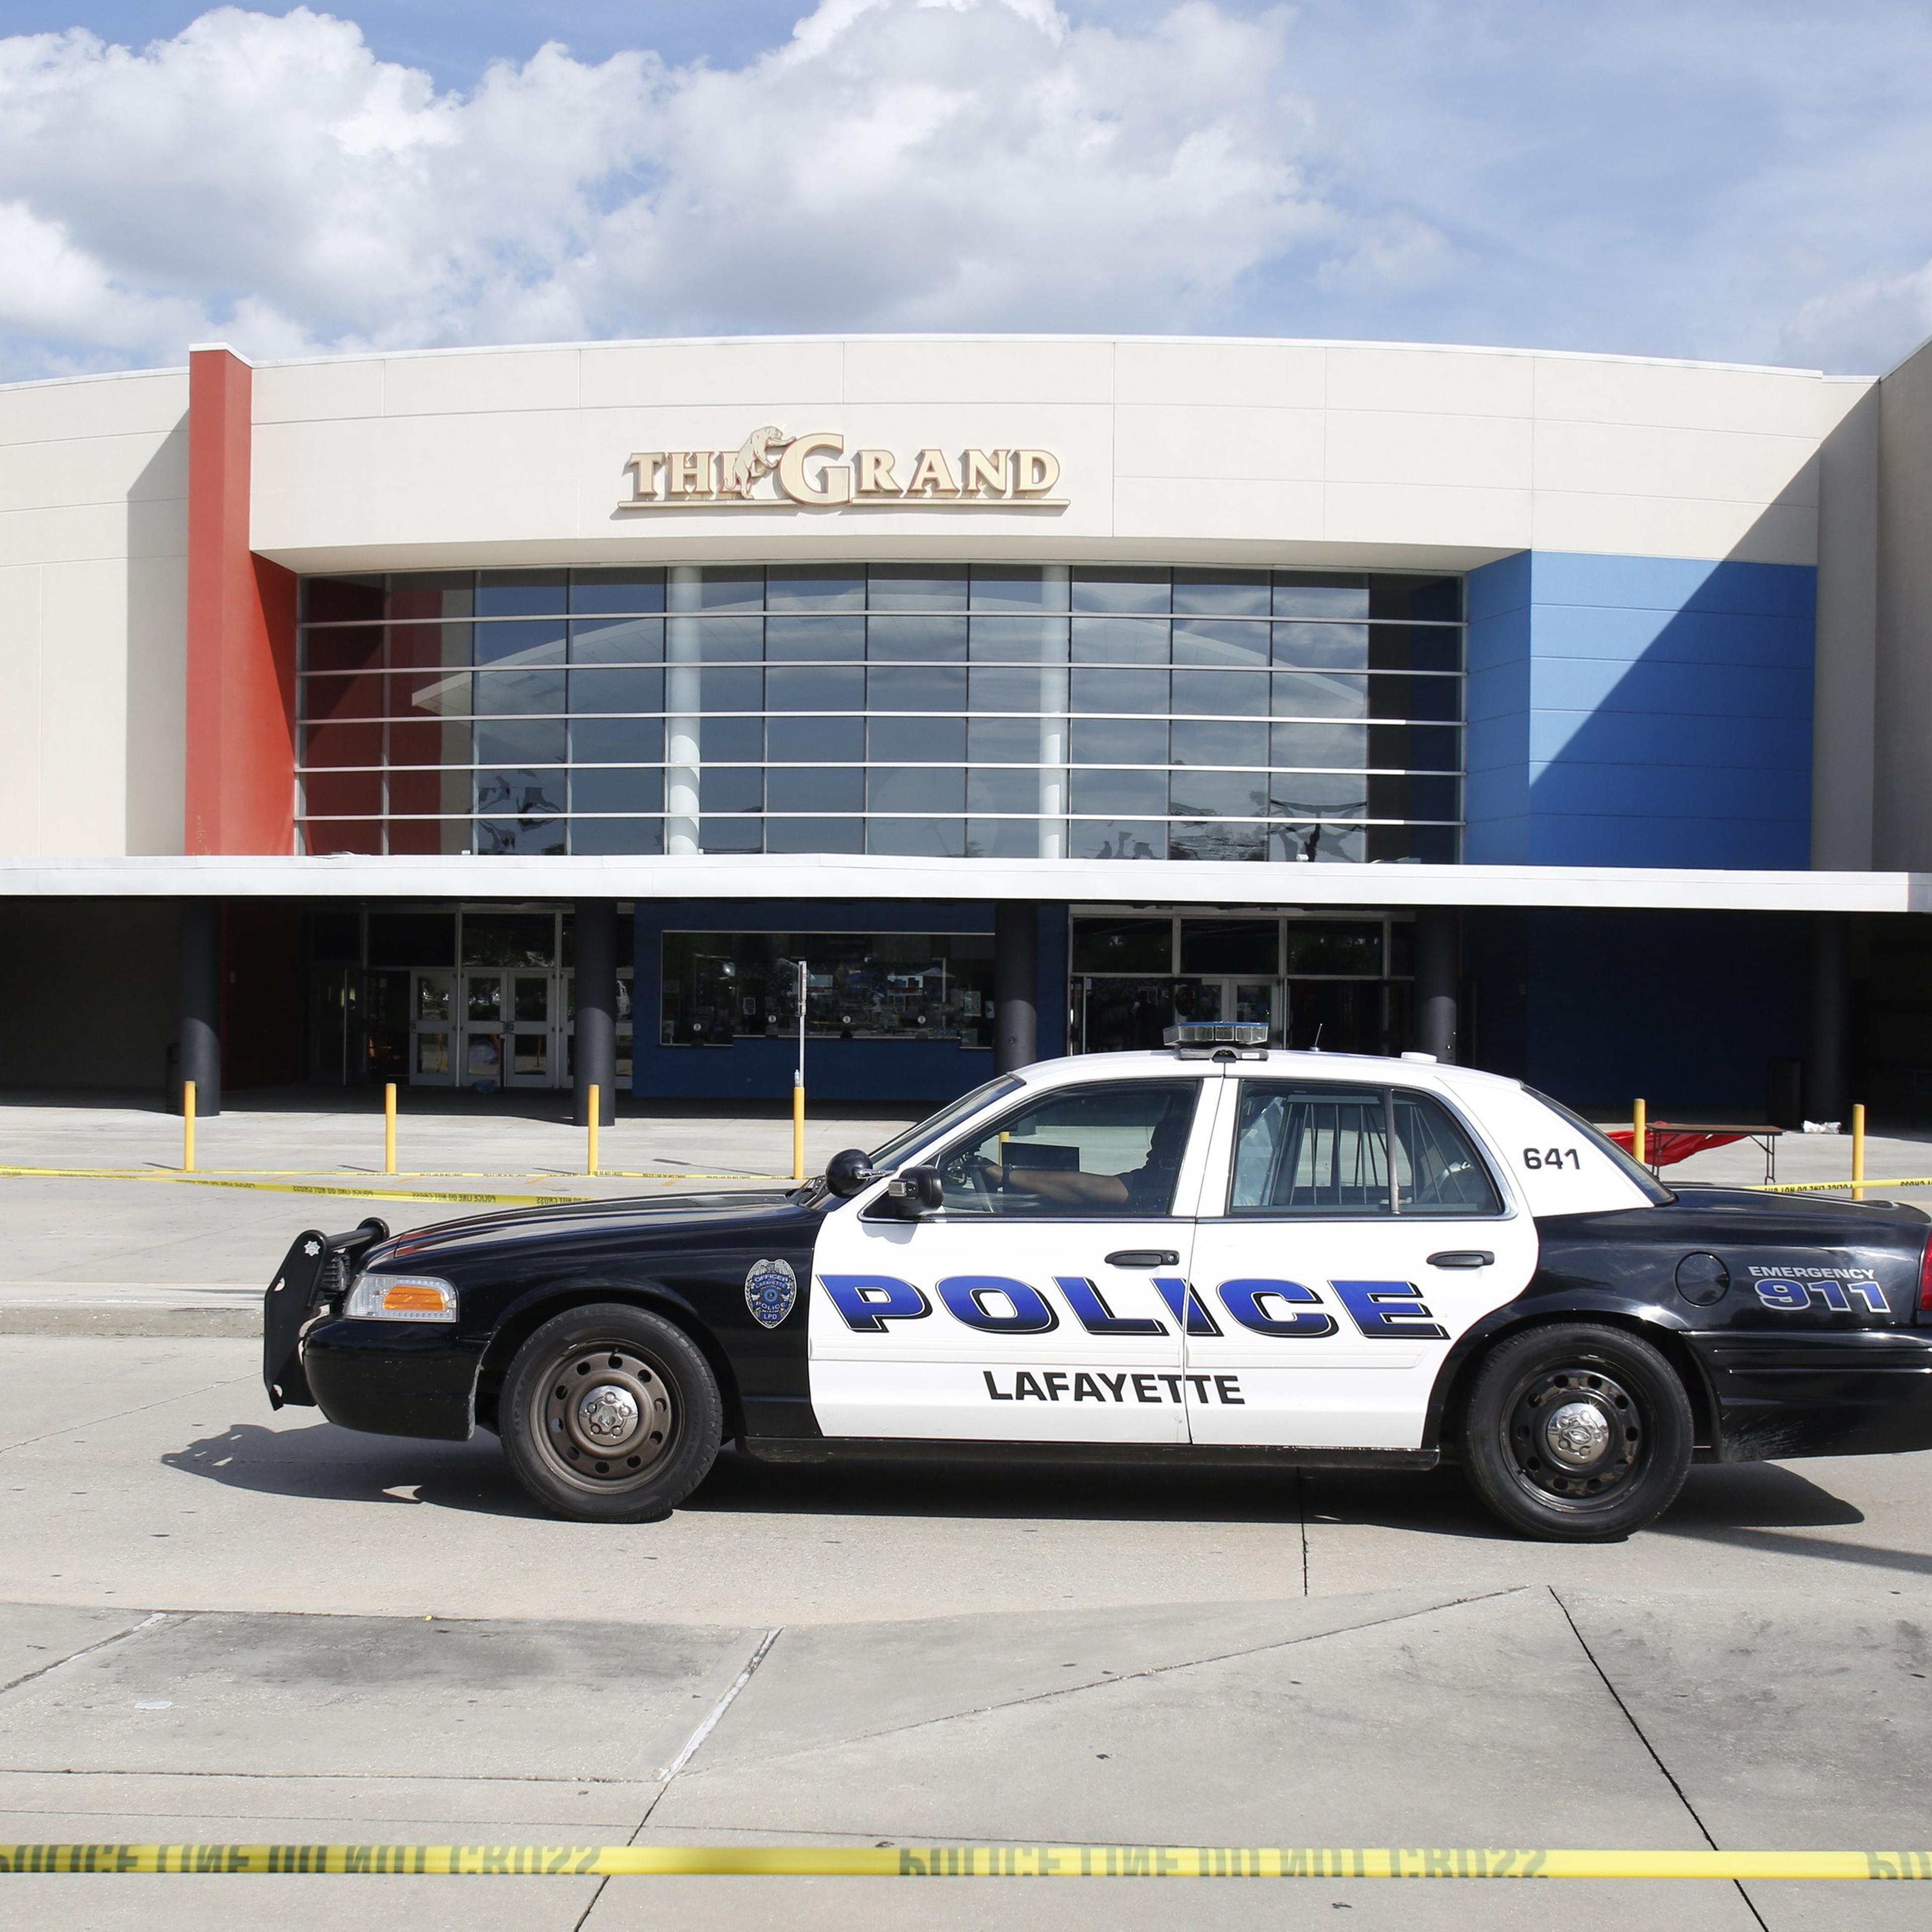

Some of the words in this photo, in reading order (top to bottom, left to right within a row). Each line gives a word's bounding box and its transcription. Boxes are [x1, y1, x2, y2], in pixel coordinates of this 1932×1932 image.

[1523, 1148, 1580, 1170] 641
[755, 1273, 788, 1282] OFFICER
[1747, 1266, 1875, 1279] EMERGENCY
[756, 1302, 786, 1310] POLICE
[815, 1273, 1451, 1339] POLICE
[1754, 1278, 1892, 1313] 911
[982, 1371, 1246, 1405] LAFAYETTE
